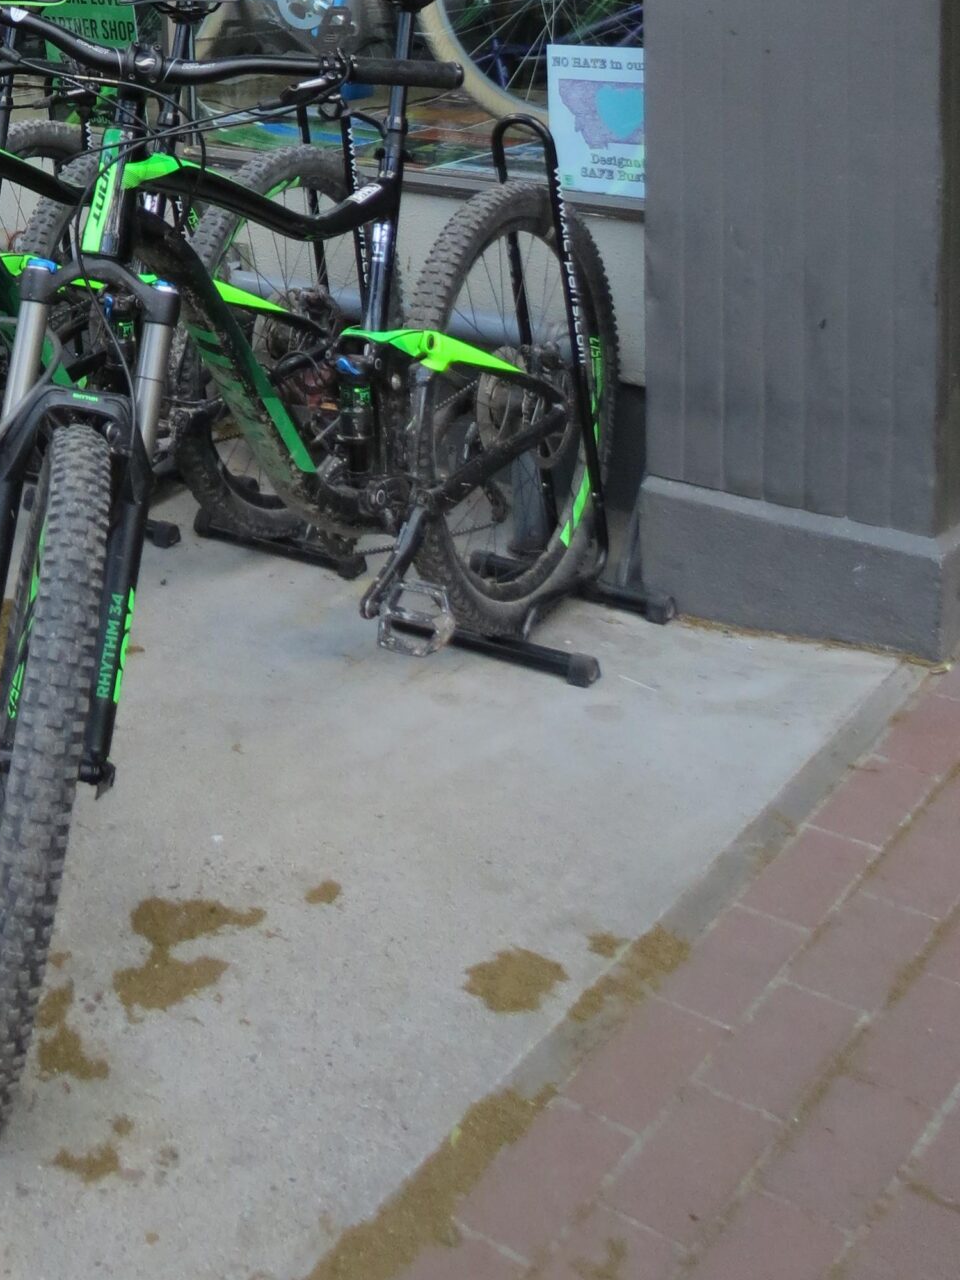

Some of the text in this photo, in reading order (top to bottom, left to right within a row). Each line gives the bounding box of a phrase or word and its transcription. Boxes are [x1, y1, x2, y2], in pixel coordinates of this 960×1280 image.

[102, 20, 136, 41] SHOP
[551, 56, 569, 67] NO
[571, 56, 608, 69] HATE
[610, 58, 623, 70] in
[580, 167, 614, 182] SAFE
[108, 592, 125, 617] 34
[96, 618, 121, 700] RHYTHM
